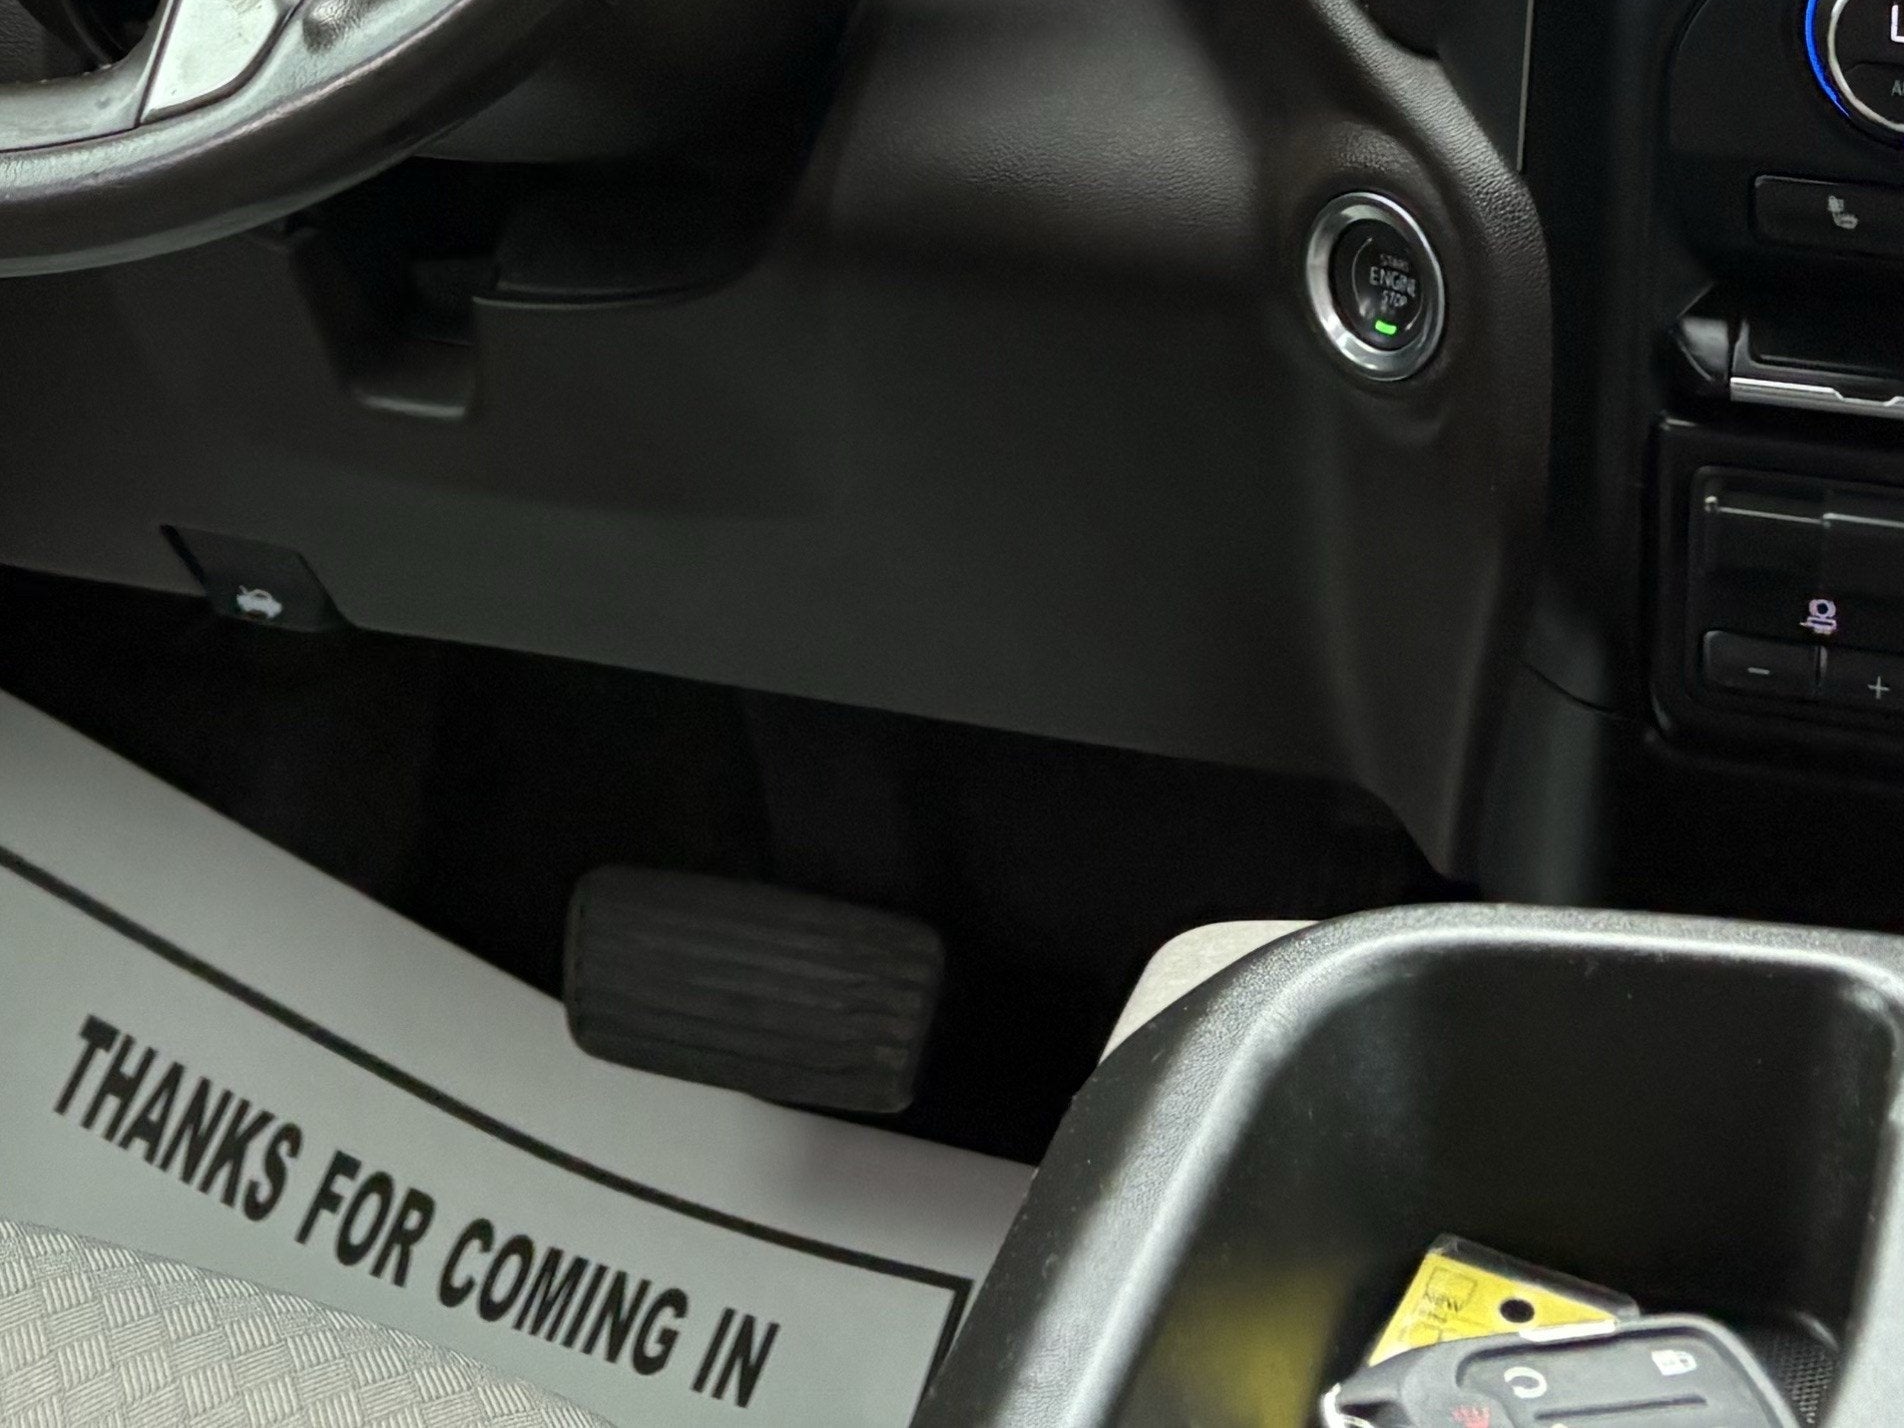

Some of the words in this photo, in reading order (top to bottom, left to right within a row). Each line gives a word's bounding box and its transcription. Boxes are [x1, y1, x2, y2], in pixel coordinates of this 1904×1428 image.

[1382, 290, 1408, 307] STOP
[52, 1013, 304, 1224] THANKS
[294, 1149, 437, 1289] FOR
[438, 1217, 689, 1378] COMING
[690, 1307, 781, 1410] IN
